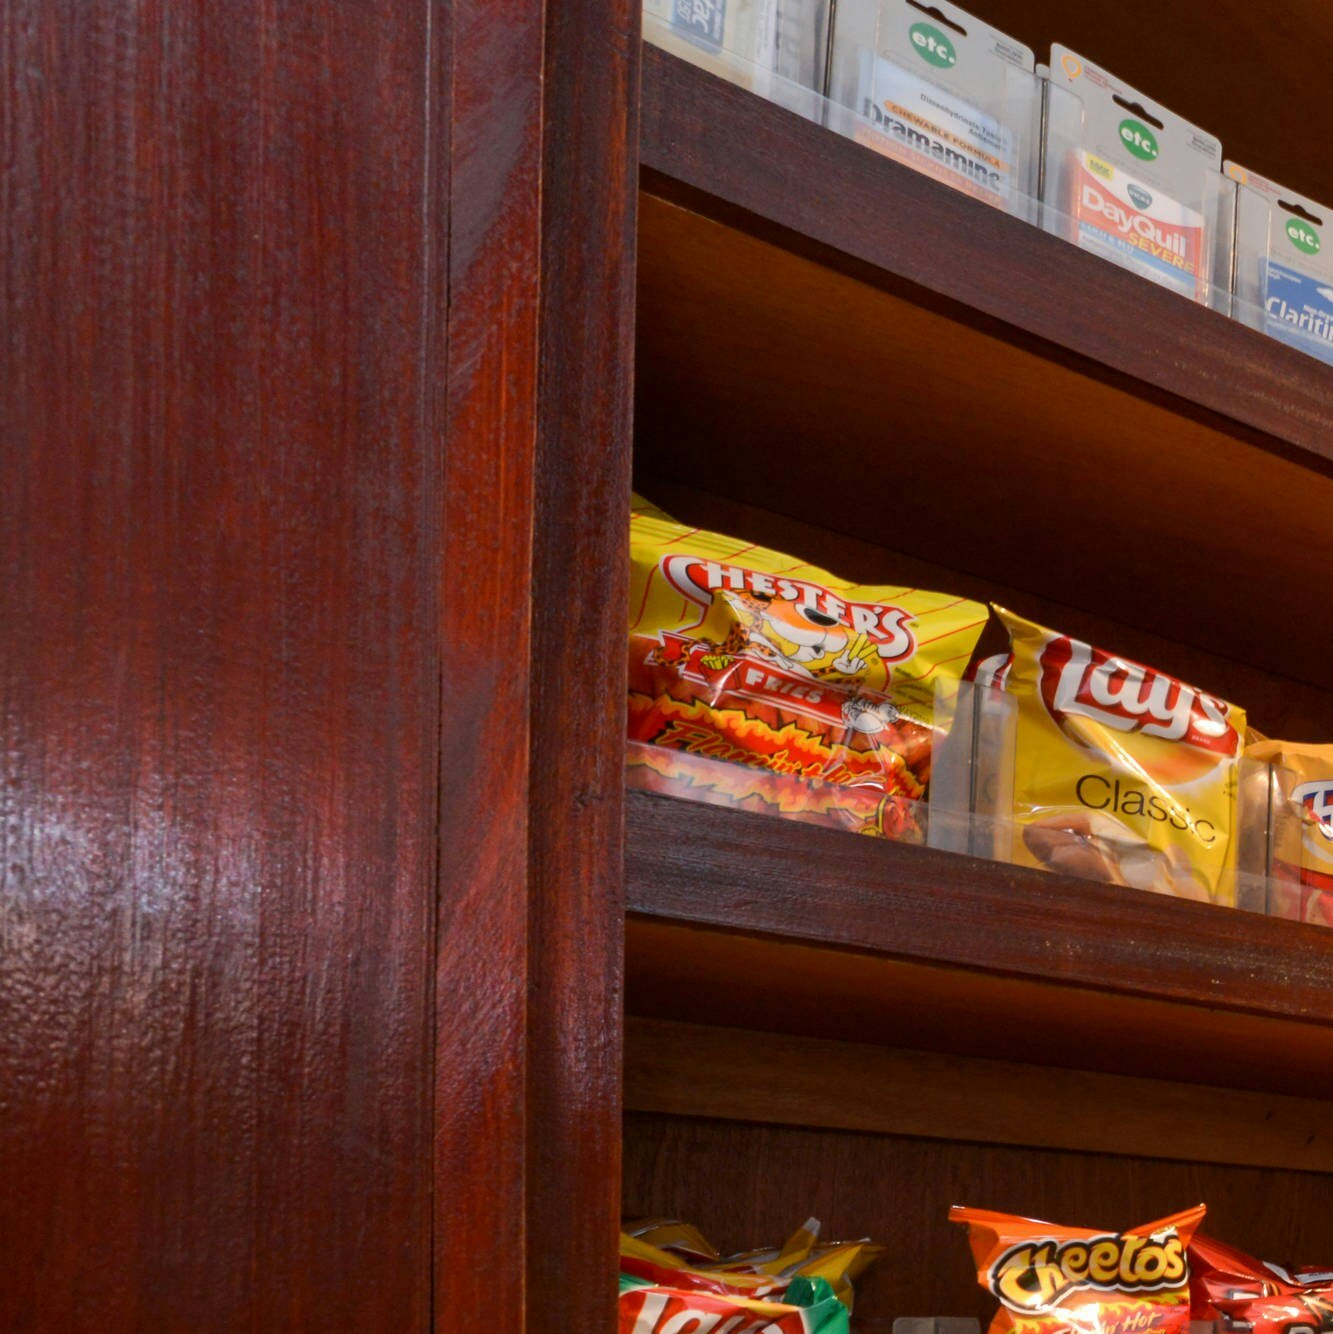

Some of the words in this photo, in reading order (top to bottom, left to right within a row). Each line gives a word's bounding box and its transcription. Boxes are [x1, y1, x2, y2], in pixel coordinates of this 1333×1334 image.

[912, 30, 956, 65] etc.
[863, 98, 1001, 190] Dramamine
[1121, 126, 1158, 157] etc.
[1082, 186, 1187, 257] DayQuil
[1287, 225, 1320, 249] etc.
[1128, 232, 1195, 273] SEVERE
[745, 668, 826, 704] FRIES
[1076, 774, 1217, 844] Classic
[996, 1233, 1187, 1307] Cheetos
[1122, 1312, 1162, 1332] Hot
